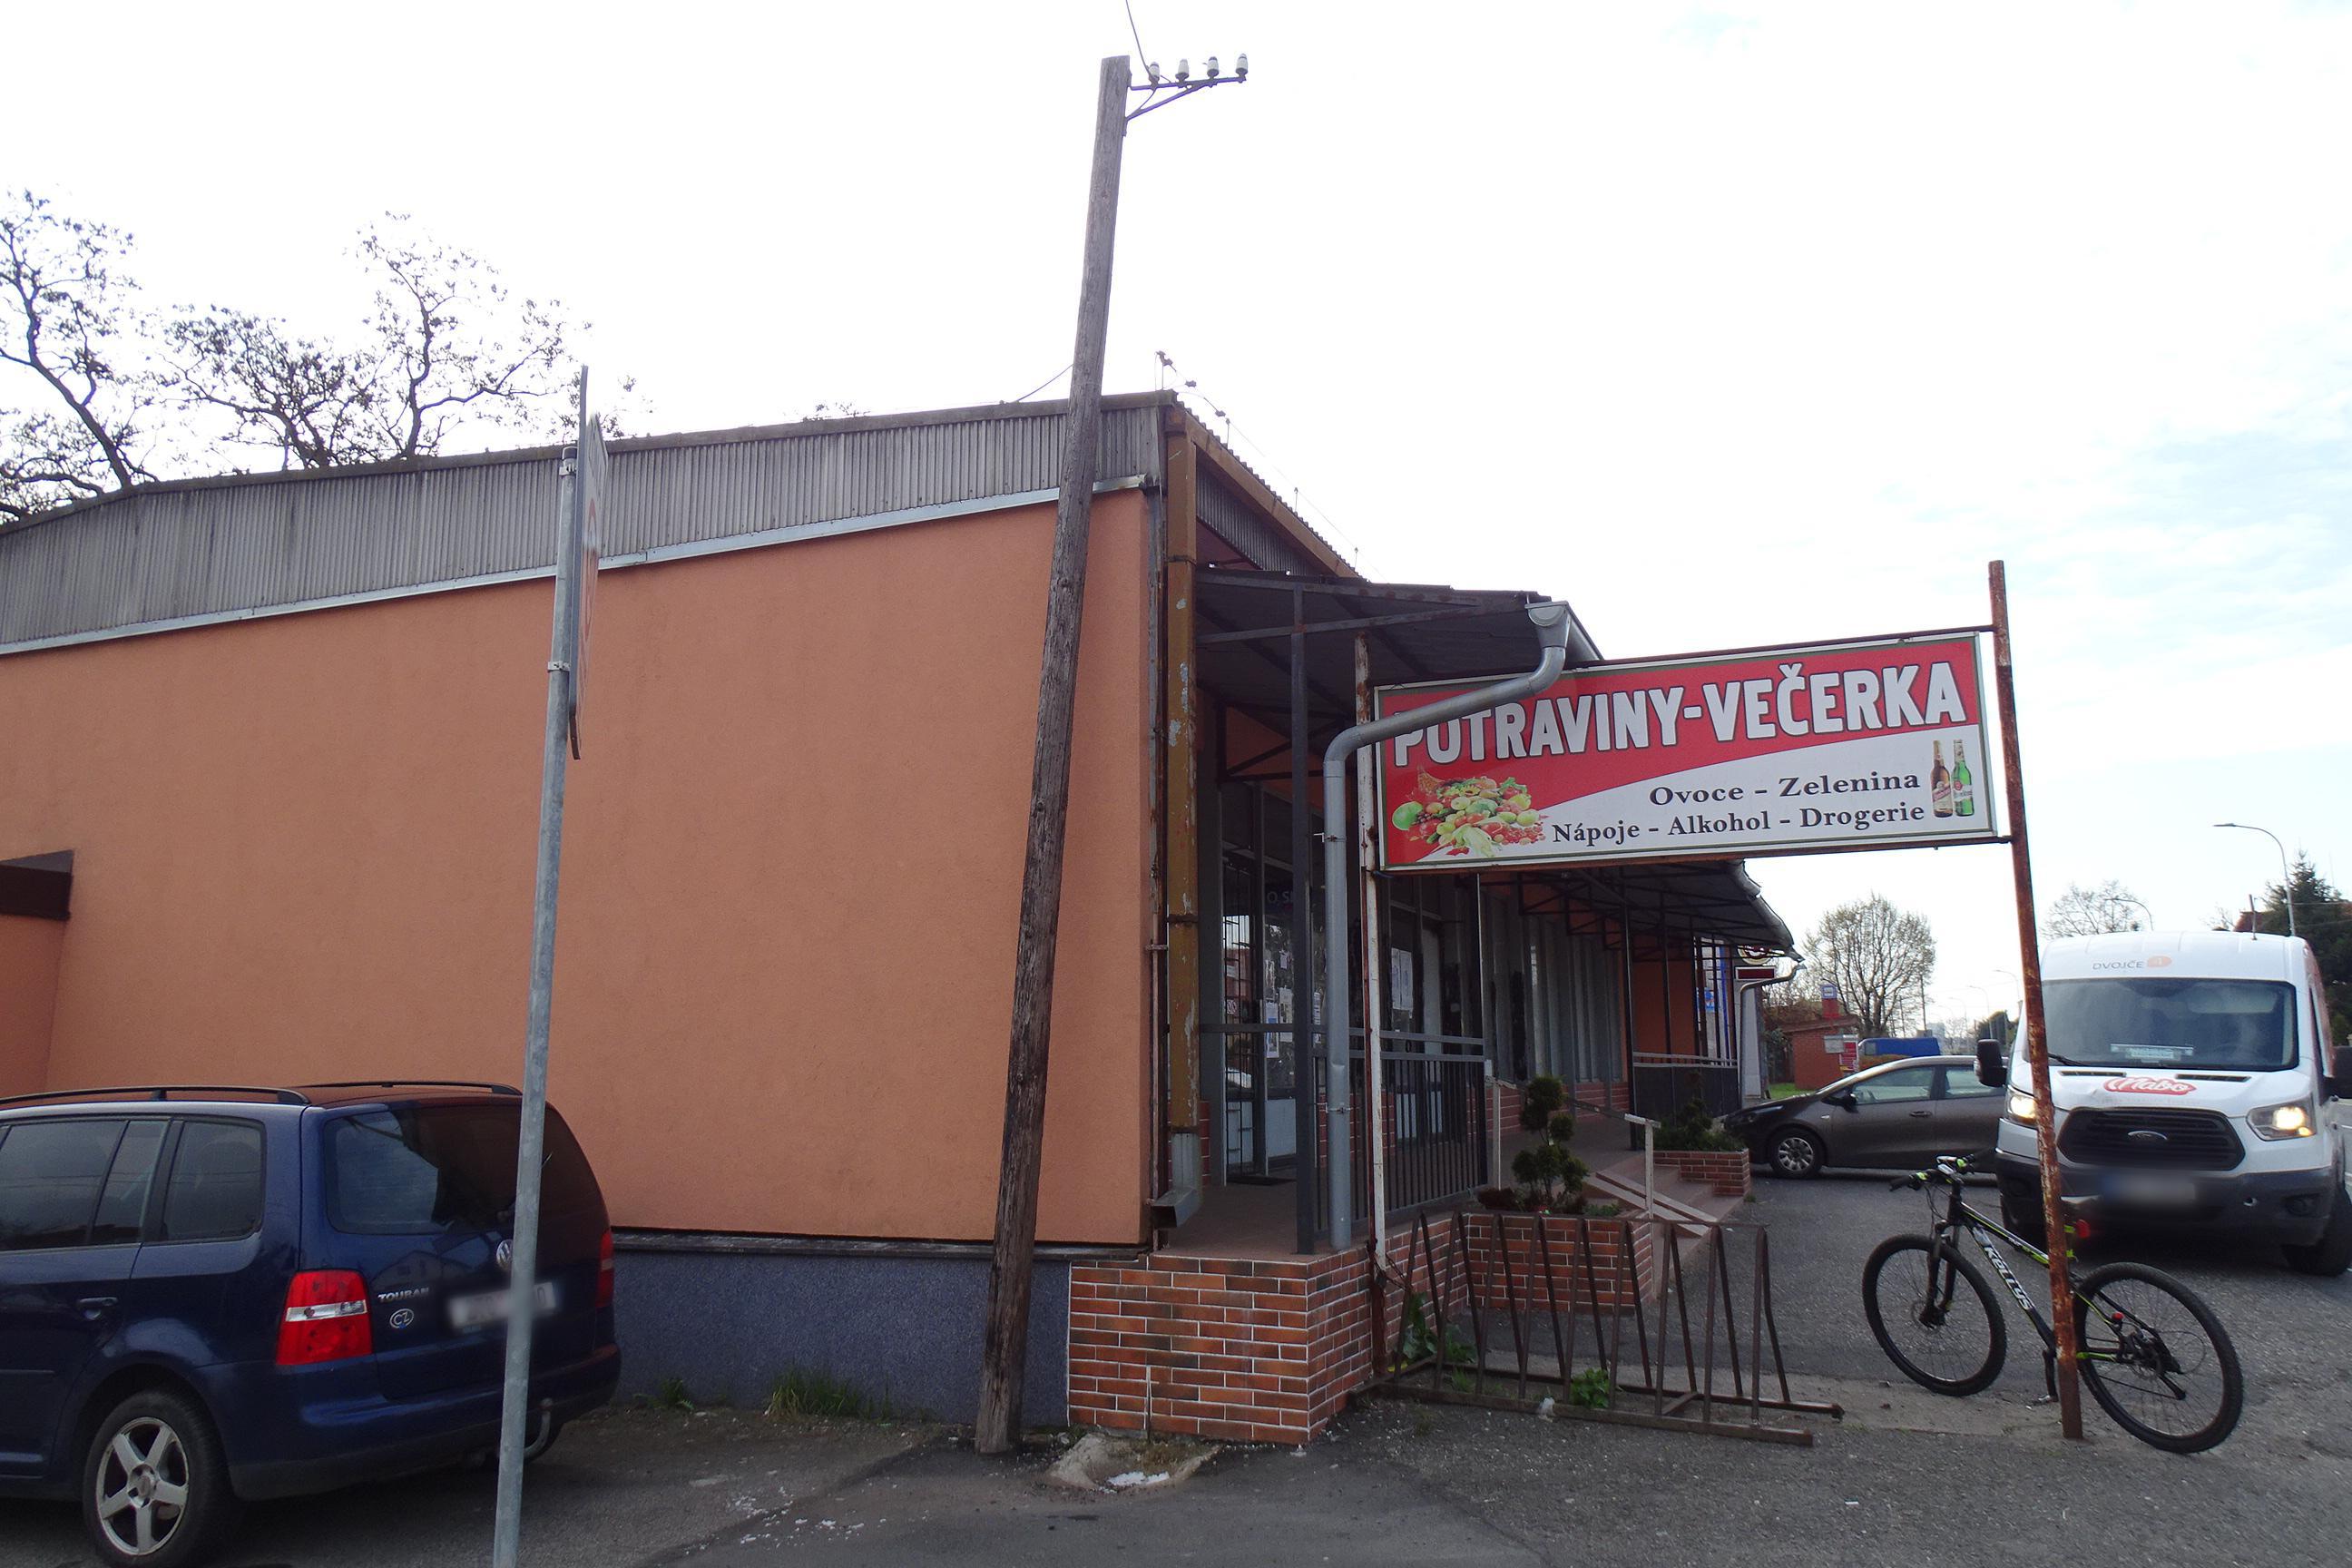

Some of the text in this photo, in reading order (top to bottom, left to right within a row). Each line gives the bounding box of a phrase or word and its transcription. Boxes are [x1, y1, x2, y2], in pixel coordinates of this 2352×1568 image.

[1649, 786, 1744, 806] Ovoce
[1779, 771, 1920, 797] Zelenina
[1553, 821, 1641, 847] Nápoje
[1667, 811, 1771, 836] Alkohol
[1799, 802, 1925, 830] Drogerie
[377, 1287, 429, 1302] TOURAN
[393, 1310, 410, 1326] CZ
